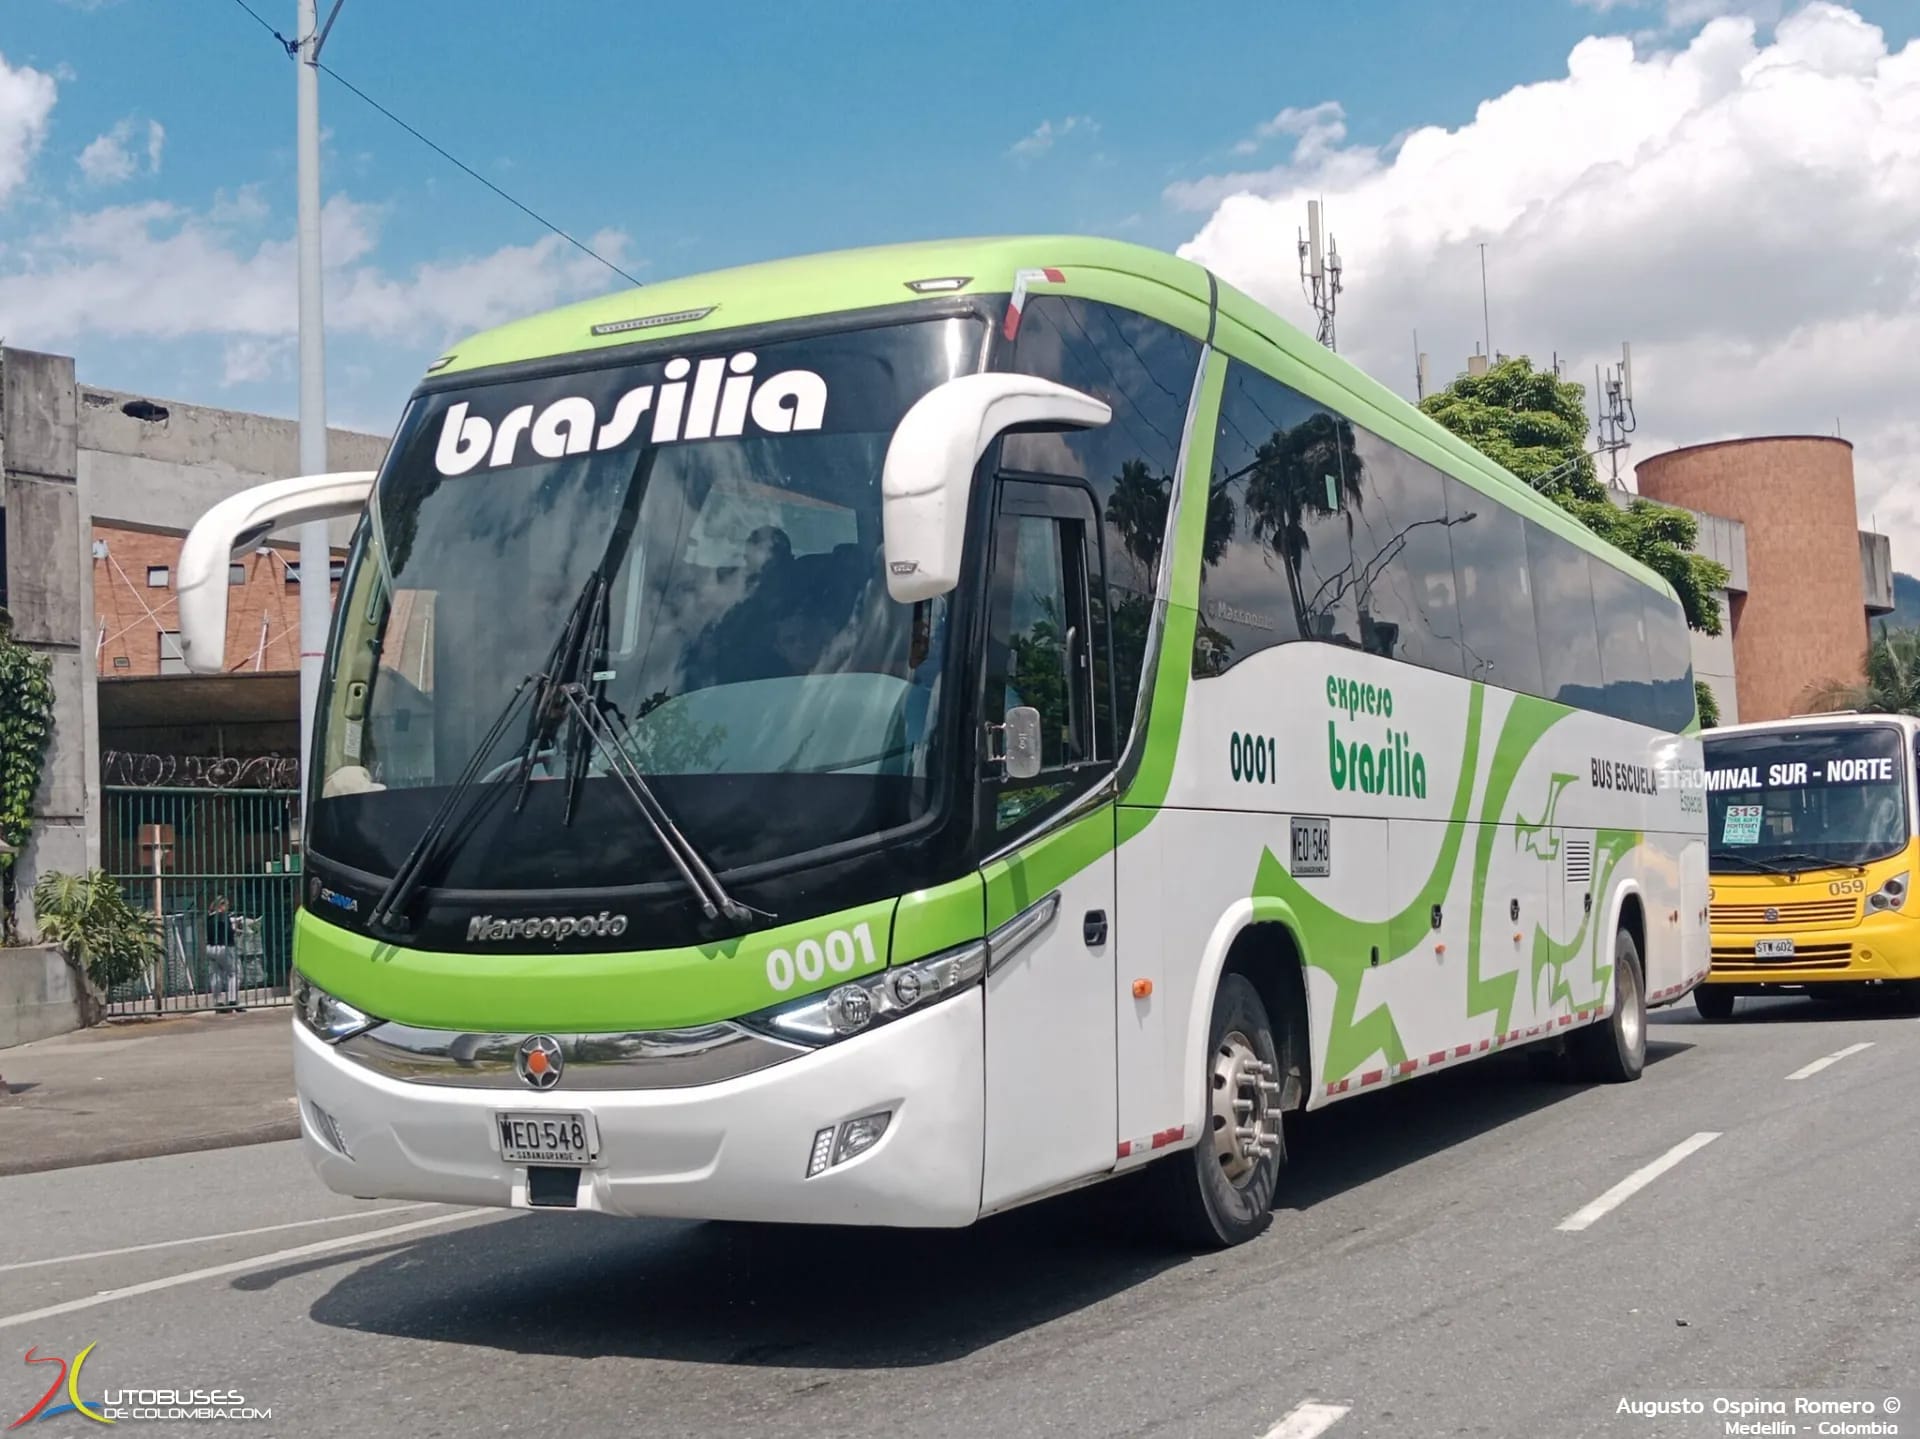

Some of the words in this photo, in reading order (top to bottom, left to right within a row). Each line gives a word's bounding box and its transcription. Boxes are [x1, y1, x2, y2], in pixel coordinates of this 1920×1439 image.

[435, 351, 828, 477] brasilia
[1326, 675, 1392, 721] expreso
[1230, 731, 1276, 784] 0001
[1328, 720, 1426, 799] brasilia
[1591, 757, 1612, 790] BUS
[1615, 762, 1657, 796] ESCUELA
[1768, 763, 1807, 786] SUR
[1827, 758, 1892, 782] NORTE
[1729, 807, 1760, 817] 313
[1829, 879, 1864, 896] 059
[466, 911, 628, 941] Marcopolo
[766, 922, 876, 991] 0001
